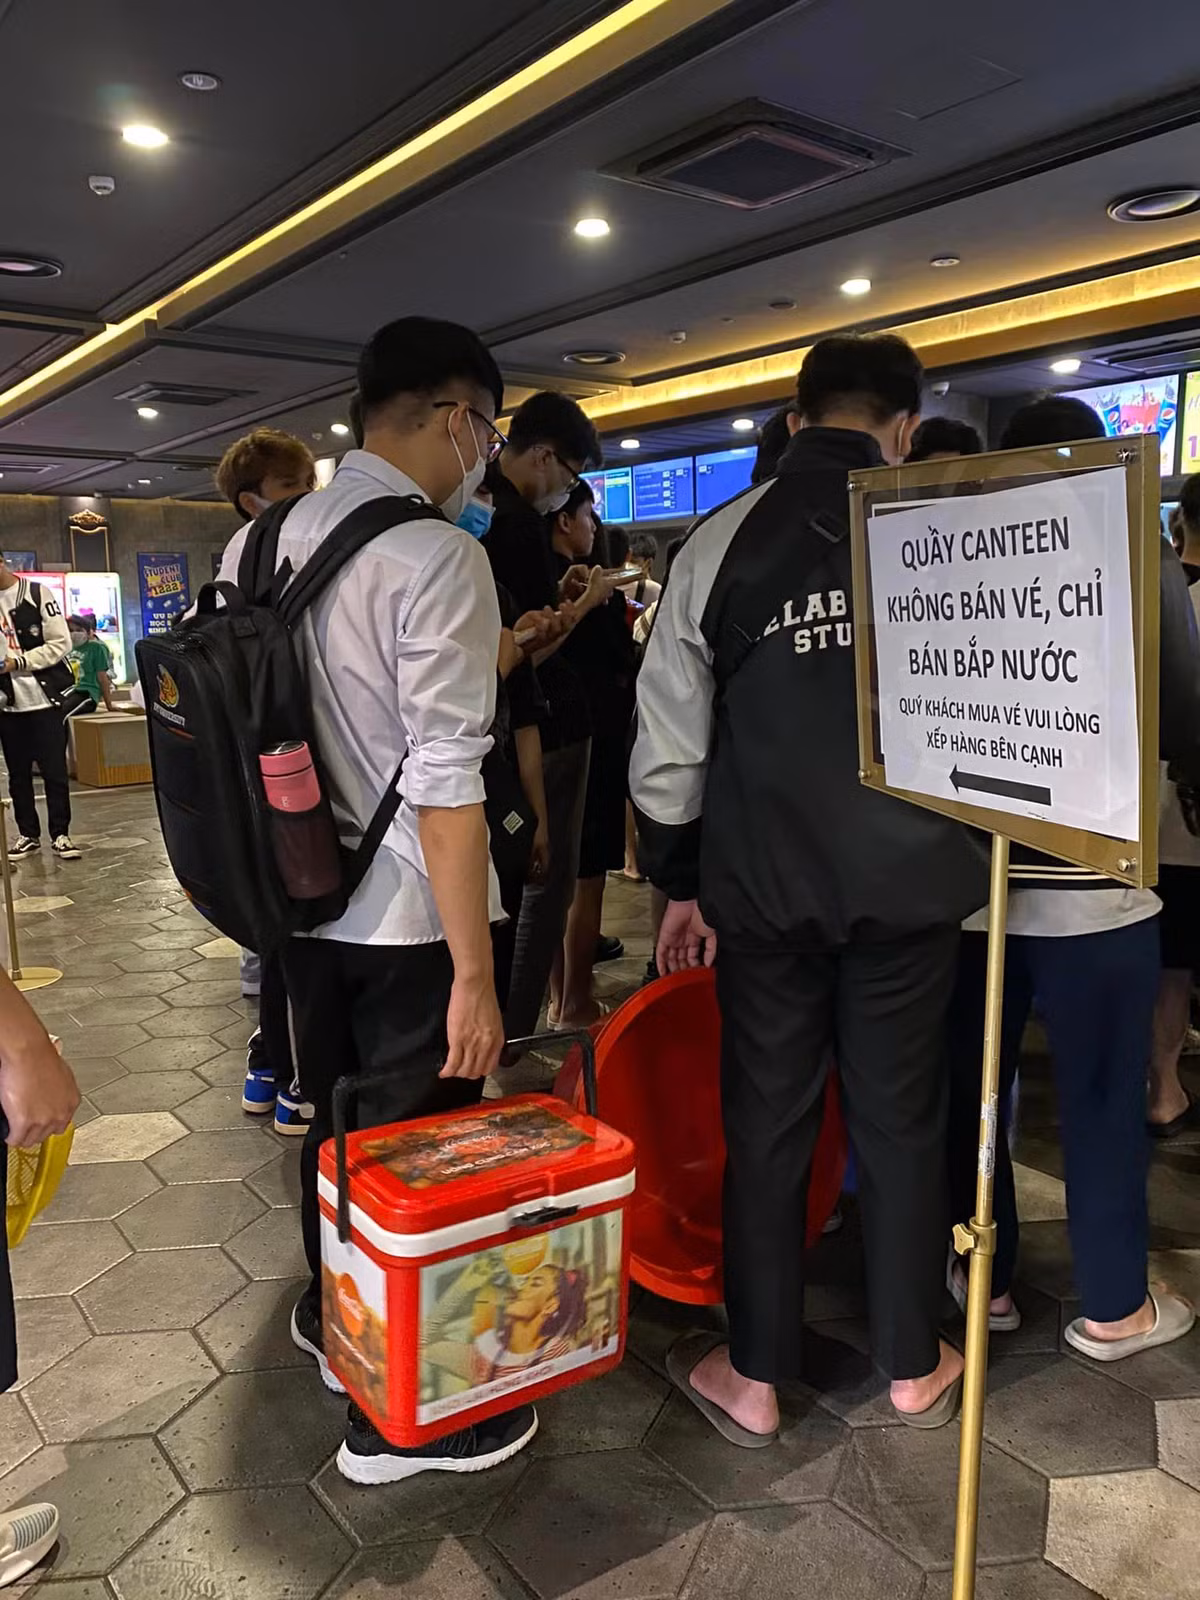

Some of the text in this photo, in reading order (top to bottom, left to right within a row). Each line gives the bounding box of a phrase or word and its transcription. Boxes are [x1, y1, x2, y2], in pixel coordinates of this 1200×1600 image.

[901, 516, 1070, 571] QUẦY CANTEEN
[145, 565, 180, 577] STUDENT
[152, 582, 179, 595] 1222
[888, 567, 1104, 624] KHÔNG BÁN VÉ, CHỈ
[909, 635, 1078, 684] BÁN BẮP NƯỚC
[899, 694, 1101, 735] QUÝ KHÁCH MUA VÉ VUI LÒNG
[926, 726, 1063, 769] XẾP HÀNG BÊN CẠNH
